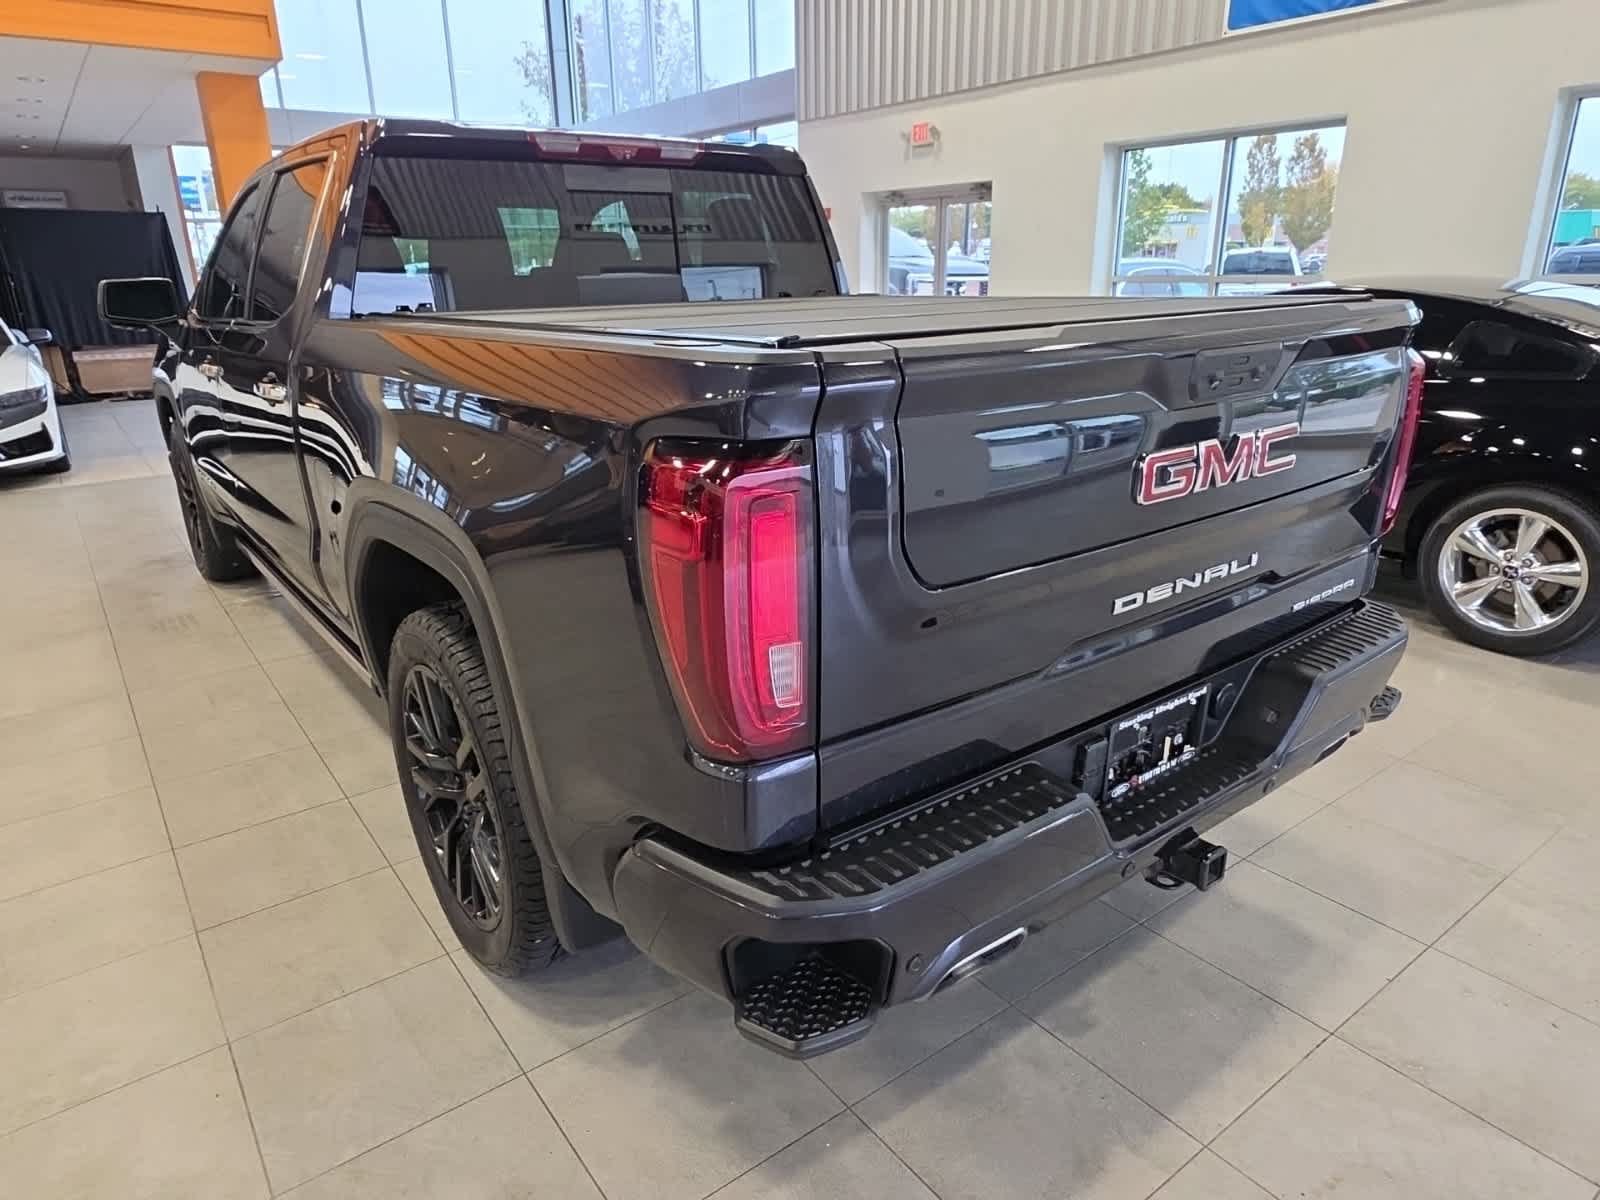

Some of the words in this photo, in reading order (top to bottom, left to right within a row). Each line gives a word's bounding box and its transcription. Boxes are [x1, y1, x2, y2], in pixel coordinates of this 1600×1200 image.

[1136, 422, 1300, 505] GMC
[1112, 552, 1258, 616] DENALI
[1292, 579, 1355, 613] SIERRA
